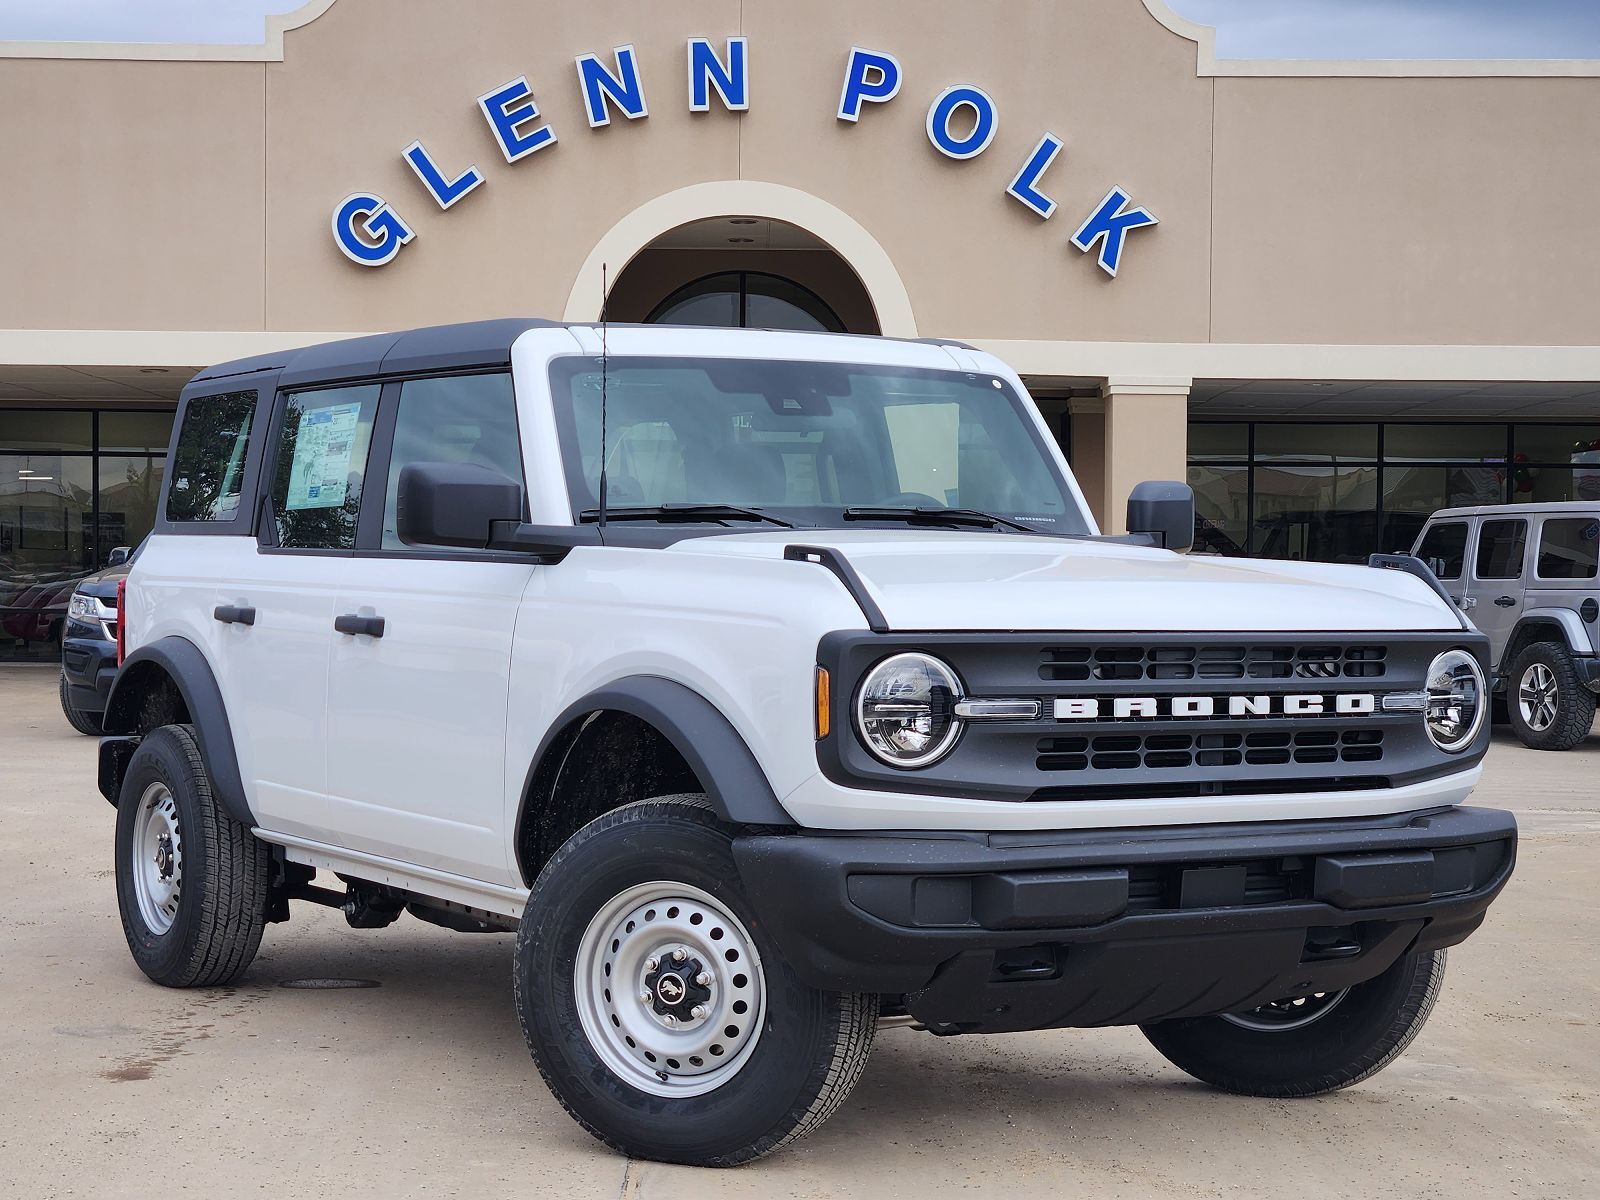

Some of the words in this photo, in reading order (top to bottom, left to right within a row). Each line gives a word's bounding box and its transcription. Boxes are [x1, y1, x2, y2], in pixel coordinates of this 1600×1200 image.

[332, 36, 750, 267] GLENN
[837, 46, 1160, 278] POLK
[1053, 693, 1375, 719] BRONCO
